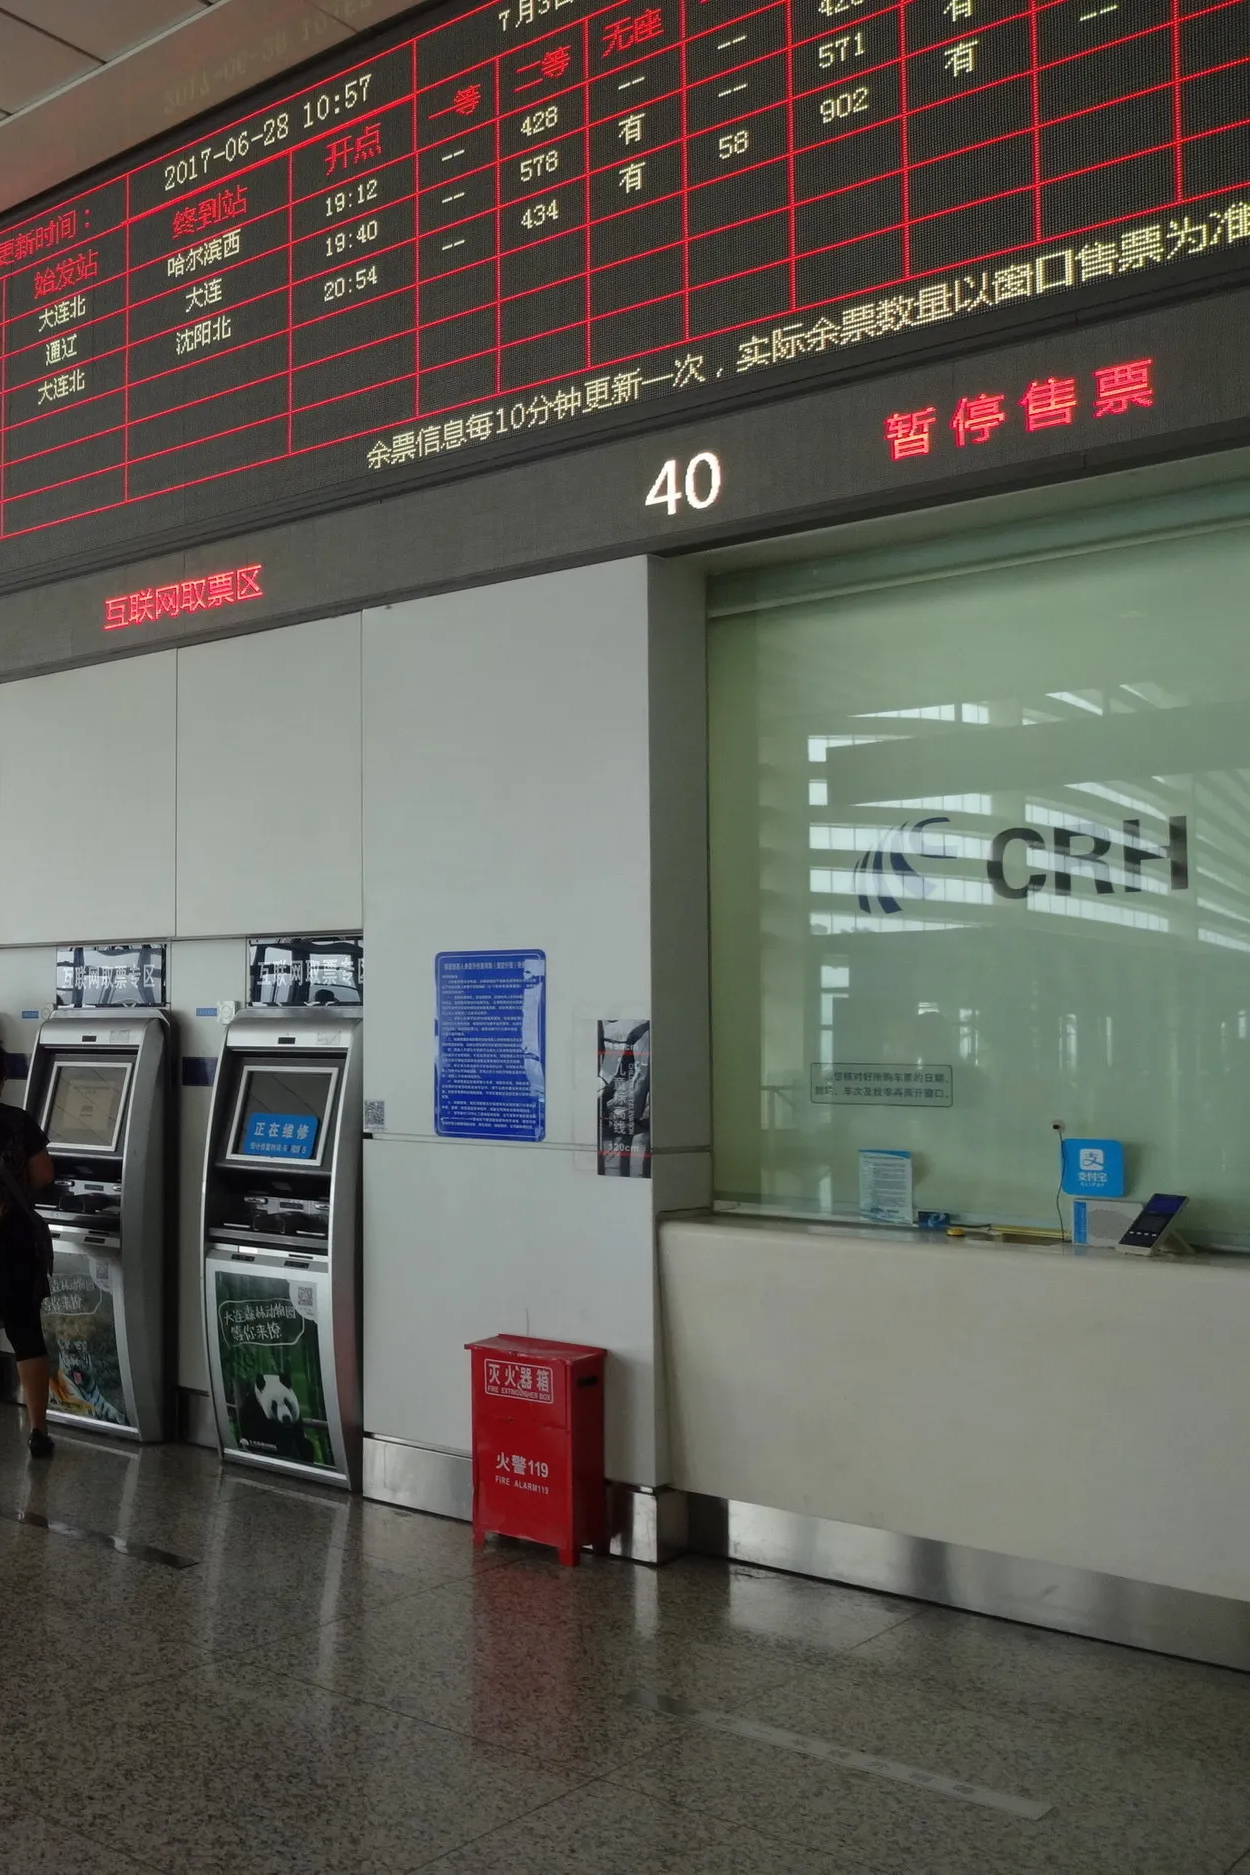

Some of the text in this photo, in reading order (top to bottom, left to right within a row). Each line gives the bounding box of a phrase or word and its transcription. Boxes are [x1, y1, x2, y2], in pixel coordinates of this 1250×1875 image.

[601, 8, 663, 58] 无座
[819, 32, 865, 68] 571
[514, 45, 571, 92] 二等
[944, 40, 979, 77] 有
[427, 84, 481, 120] 一等
[820, 87, 869, 124] 902
[164, 75, 371, 192] 2017-06-28 10:57
[521, 105, 558, 136] 428
[619, 113, 645, 145] 有
[325, 124, 381, 175] 开点
[719, 130, 749, 160] 58
[521, 151, 558, 181] 578
[619, 162, 645, 193] 有
[172, 186, 247, 240] 终到站
[324, 179, 377, 216] 19:12
[521, 200, 558, 229] 434
[167, 229, 240, 278] 哈尔滨西
[324, 220, 377, 257] 19:40
[34, 250, 97, 298] 始发站
[324, 266, 377, 302] 20:54
[38, 295, 86, 332] 大连北
[185, 279, 223, 313] 大连
[46, 334, 78, 366] 通辽
[175, 317, 231, 355] 沈阳北
[38, 369, 86, 405] 大连北
[884, 359, 1153, 461] 暂停售票
[644, 452, 721, 516] 40
[103, 564, 263, 631] 互联网取票区
[986, 816, 1188, 900] CRH
[62, 963, 155, 990] 互联网取票专区
[254, 1122, 310, 1139] 正在维修
[488, 1363, 549, 1392] 灭火器箱
[496, 1452, 549, 1478] 火警119
[495, 1475, 549, 1495] FIRE ALARM119
